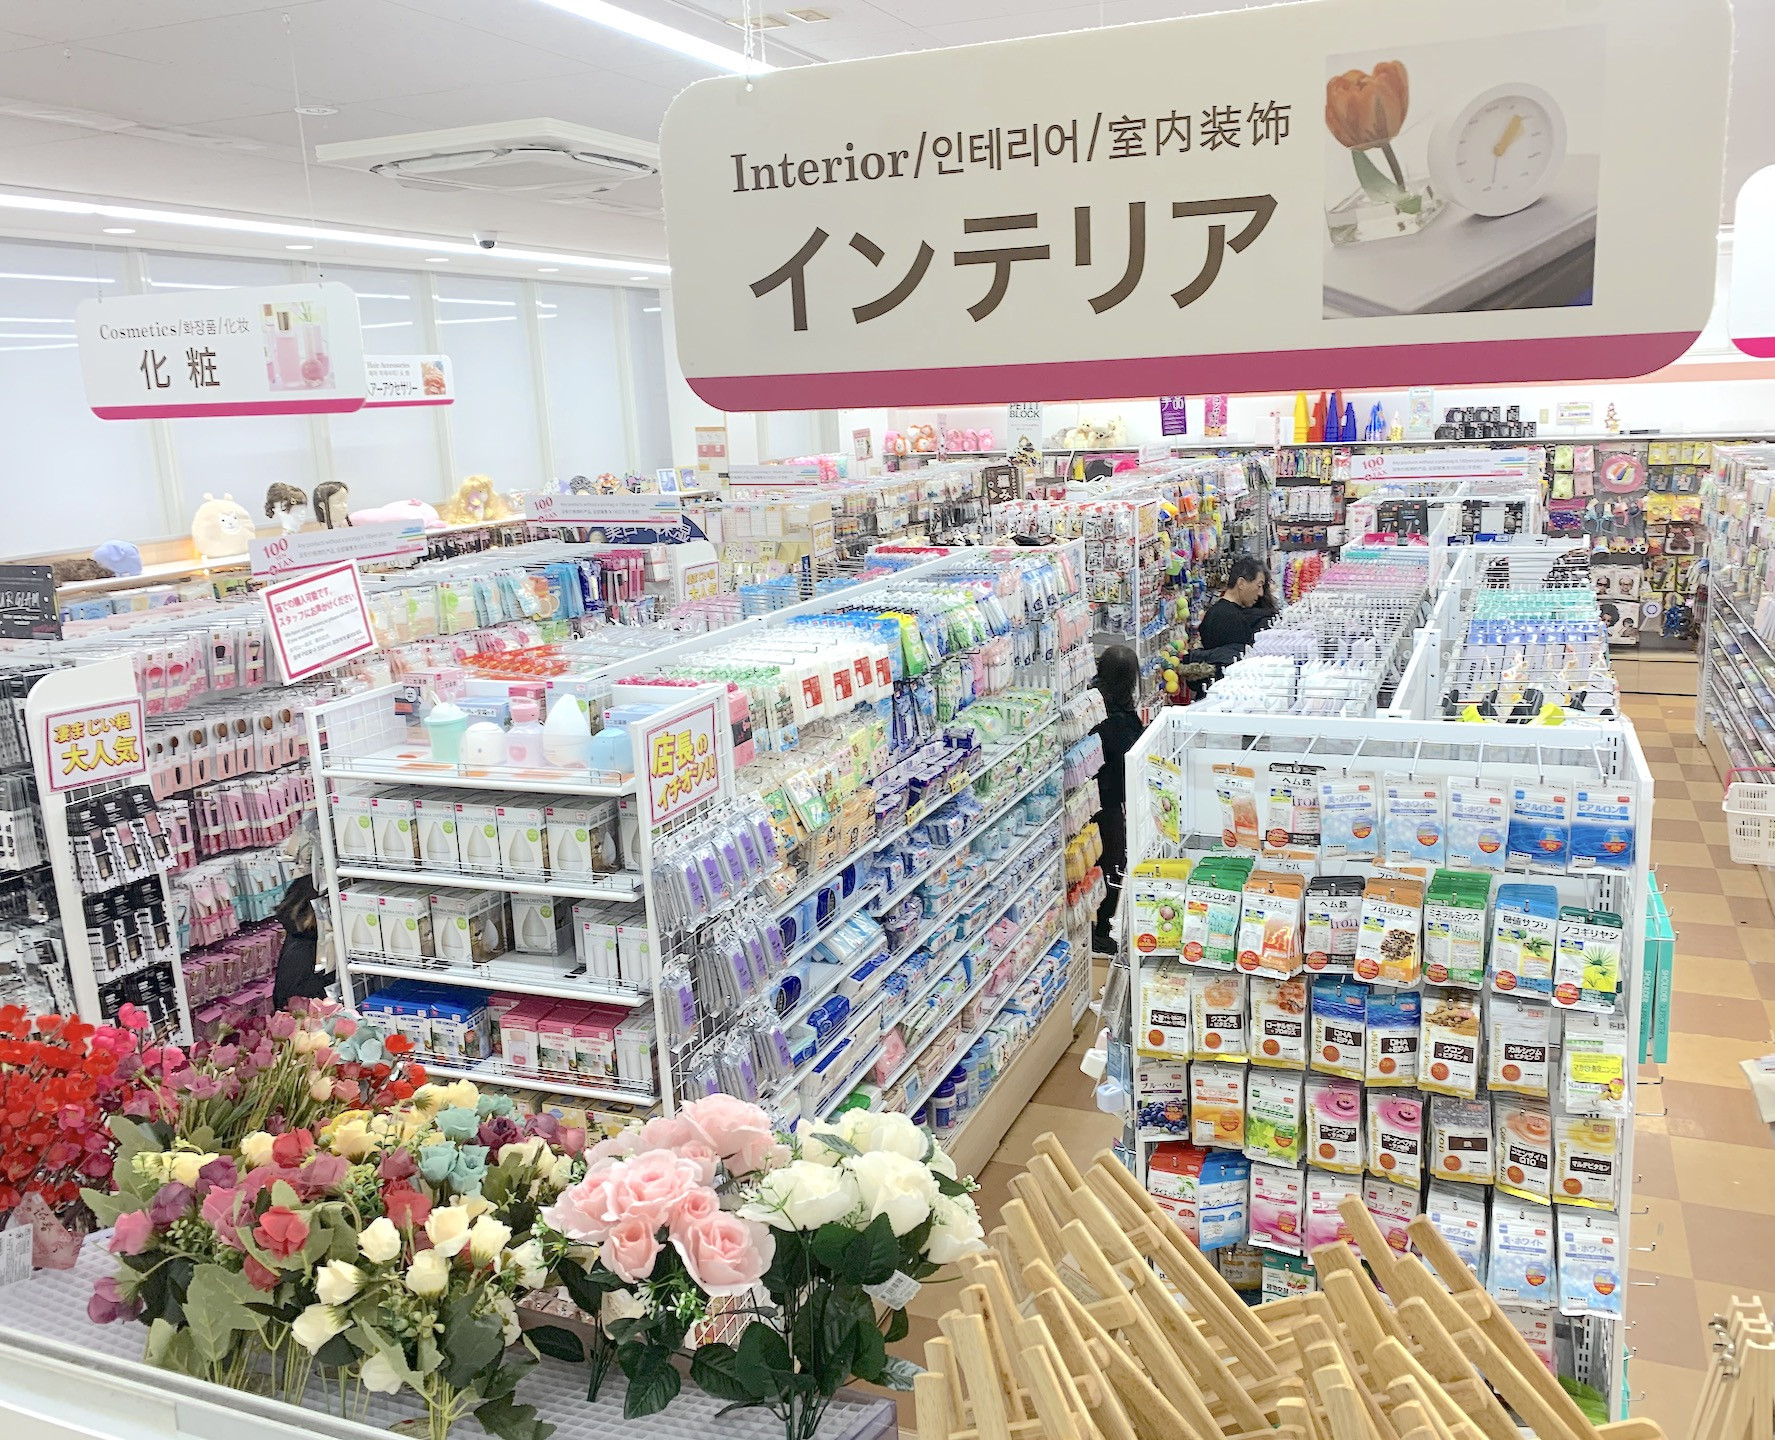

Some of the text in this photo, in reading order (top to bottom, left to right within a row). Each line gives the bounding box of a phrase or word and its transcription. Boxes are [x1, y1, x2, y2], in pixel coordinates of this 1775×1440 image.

[731, 100, 1292, 193] Interior/인테리어/室内装饰
[749, 194, 1278, 332] インテリア
[99, 317, 250, 340] Cosmetics/화장품/化妆
[1009, 410, 1041, 418] BLOCK
[1362, 457, 1384, 470] 100
[534, 496, 553, 511] 100
[262, 538, 289, 559] 100
[53, 711, 132, 744] 凄まじい程
[61, 735, 140, 776] 大人気
[651, 729, 708, 779] 店長の
[1282, 777, 1312, 787] ヘム鉄
[1515, 802, 1564, 814] ヒアルロン酸
[1578, 804, 1629, 815] ヒアルロン酸
[1147, 882, 1172, 890] マカ
[1191, 890, 1237, 903] ヒアルロン酸
[1319, 900, 1349, 909] ヘム鉄
[1370, 904, 1413, 918] プロポリス
[1429, 908, 1481, 921] ミネラルミックス
[1561, 926, 1619, 940] ノコギリヤシ
[1333, 1029, 1353, 1039] DHA
[1443, 1045, 1465, 1054] ウコン
[1507, 1046, 1543, 1056] カルシウム
[1518, 1156, 1537, 1167] Q10
[1571, 1160, 1610, 1172] マルチビタミン
[1258, 1187, 1294, 1199] コラーゲン
[1502, 1235, 1543, 1247] 美・ホワイト
[1568, 1244, 1611, 1254] 美・ホワイト
